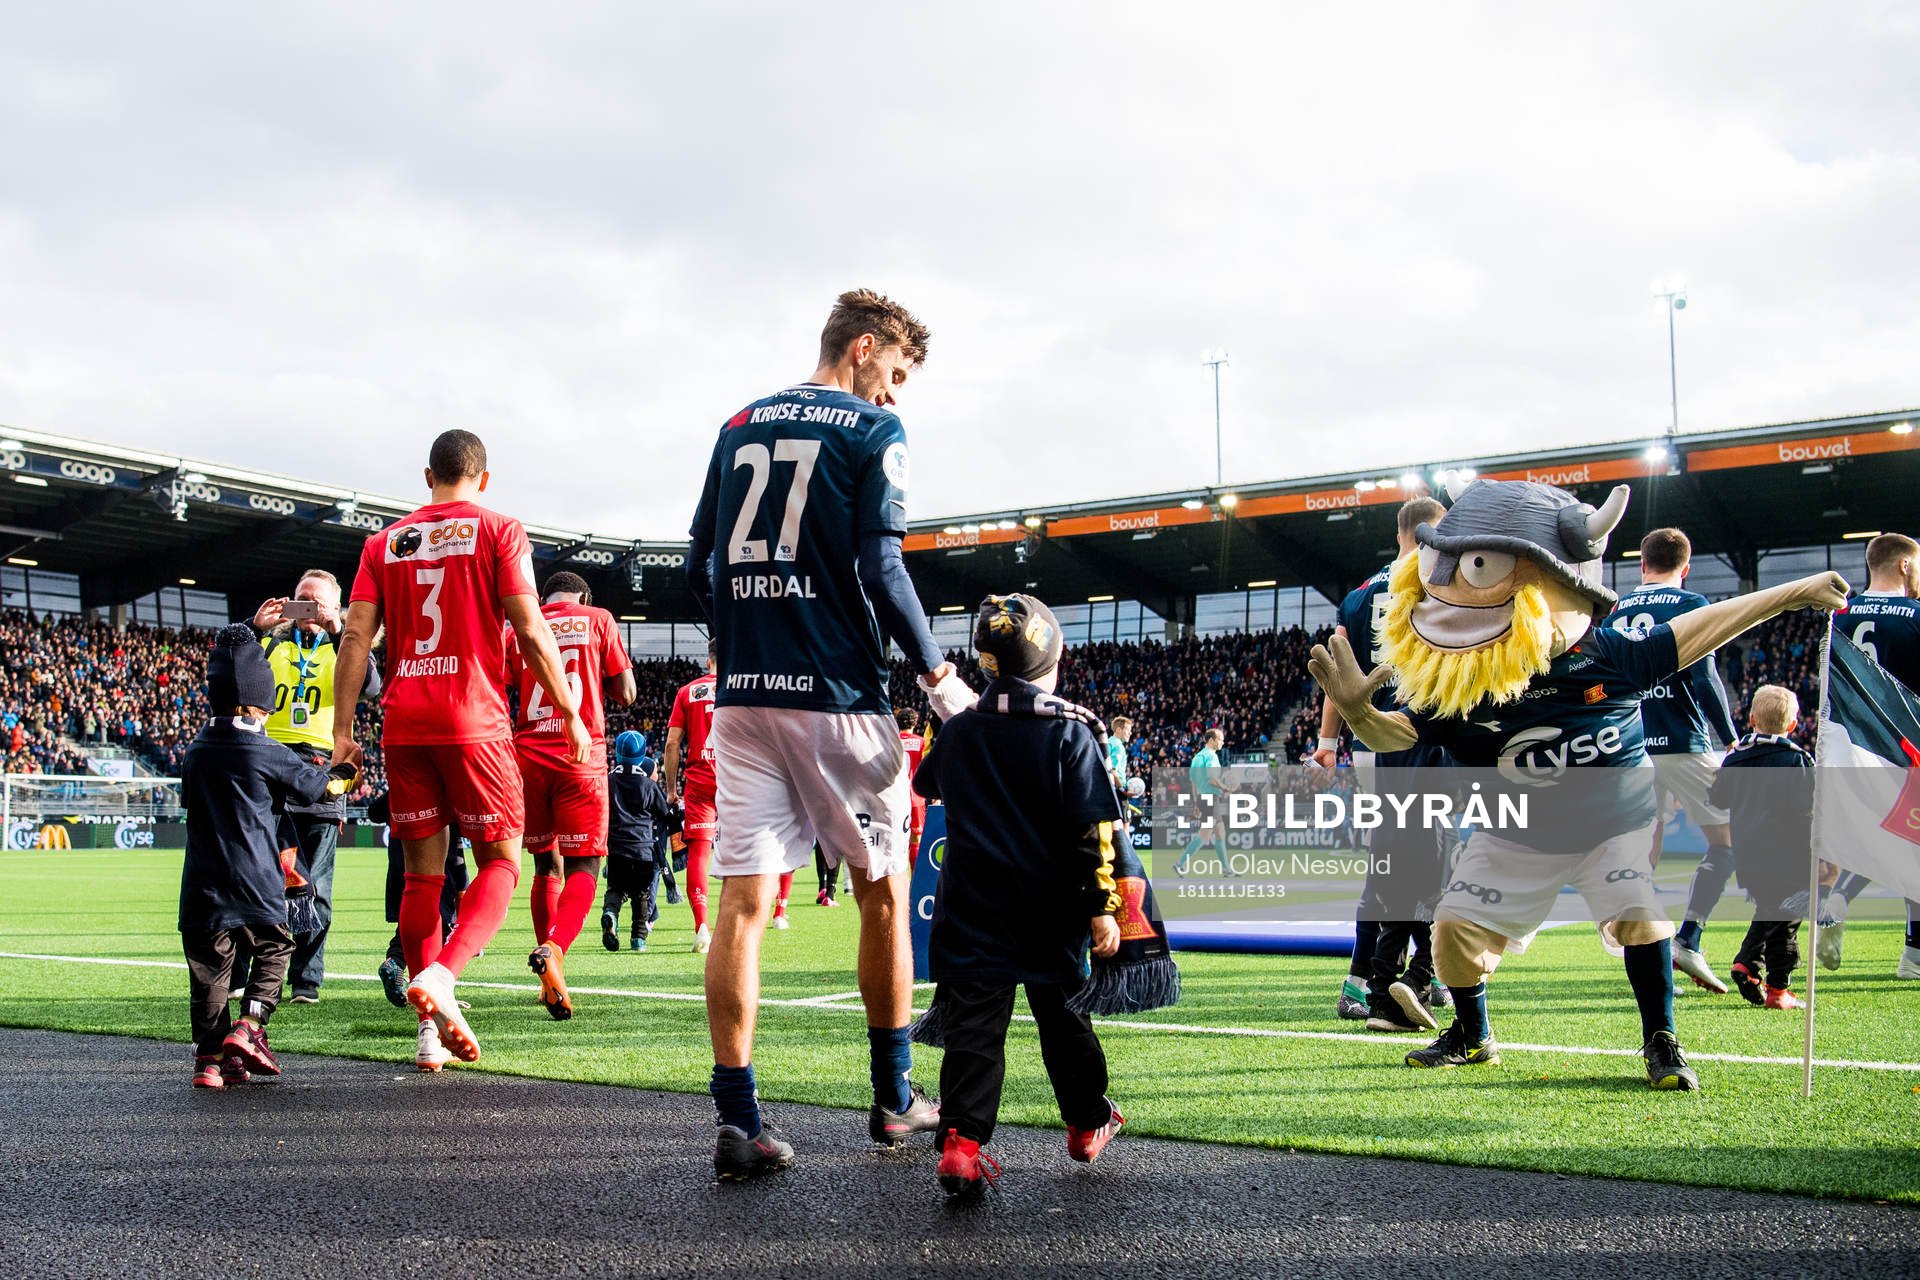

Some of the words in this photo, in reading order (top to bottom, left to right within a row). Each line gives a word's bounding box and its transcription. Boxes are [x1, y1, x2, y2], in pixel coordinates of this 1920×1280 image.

[750, 403, 801, 424] KRUSE
[800, 406, 860, 429] SMITH
[1779, 437, 1851, 462] bouvet
[60, 460, 116, 485] coop
[1526, 463, 1590, 485] bouvet
[249, 493, 296, 516] coop
[729, 439, 822, 565] 27
[1306, 491, 1361, 512] bouvet
[429, 520, 473, 545] eda
[1109, 512, 1160, 531] bouvet
[428, 540, 472, 553] supermarket
[935, 533, 980, 548] bouvet
[637, 553, 685, 568] coop
[731, 575, 817, 601] FURDAL
[415, 567, 446, 655] 3
[1618, 595, 1647, 611] KRUSE
[1646, 594, 1681, 605] SMITH
[1850, 604, 1880, 615] KRUSE
[1880, 604, 1916, 618] SMITH
[726, 673, 760, 690] MITT
[763, 673, 814, 692] VALG!
[1526, 726, 1623, 778] Lyse
[123, 827, 154, 849] Lyse
[1228, 831, 1254, 850] og
